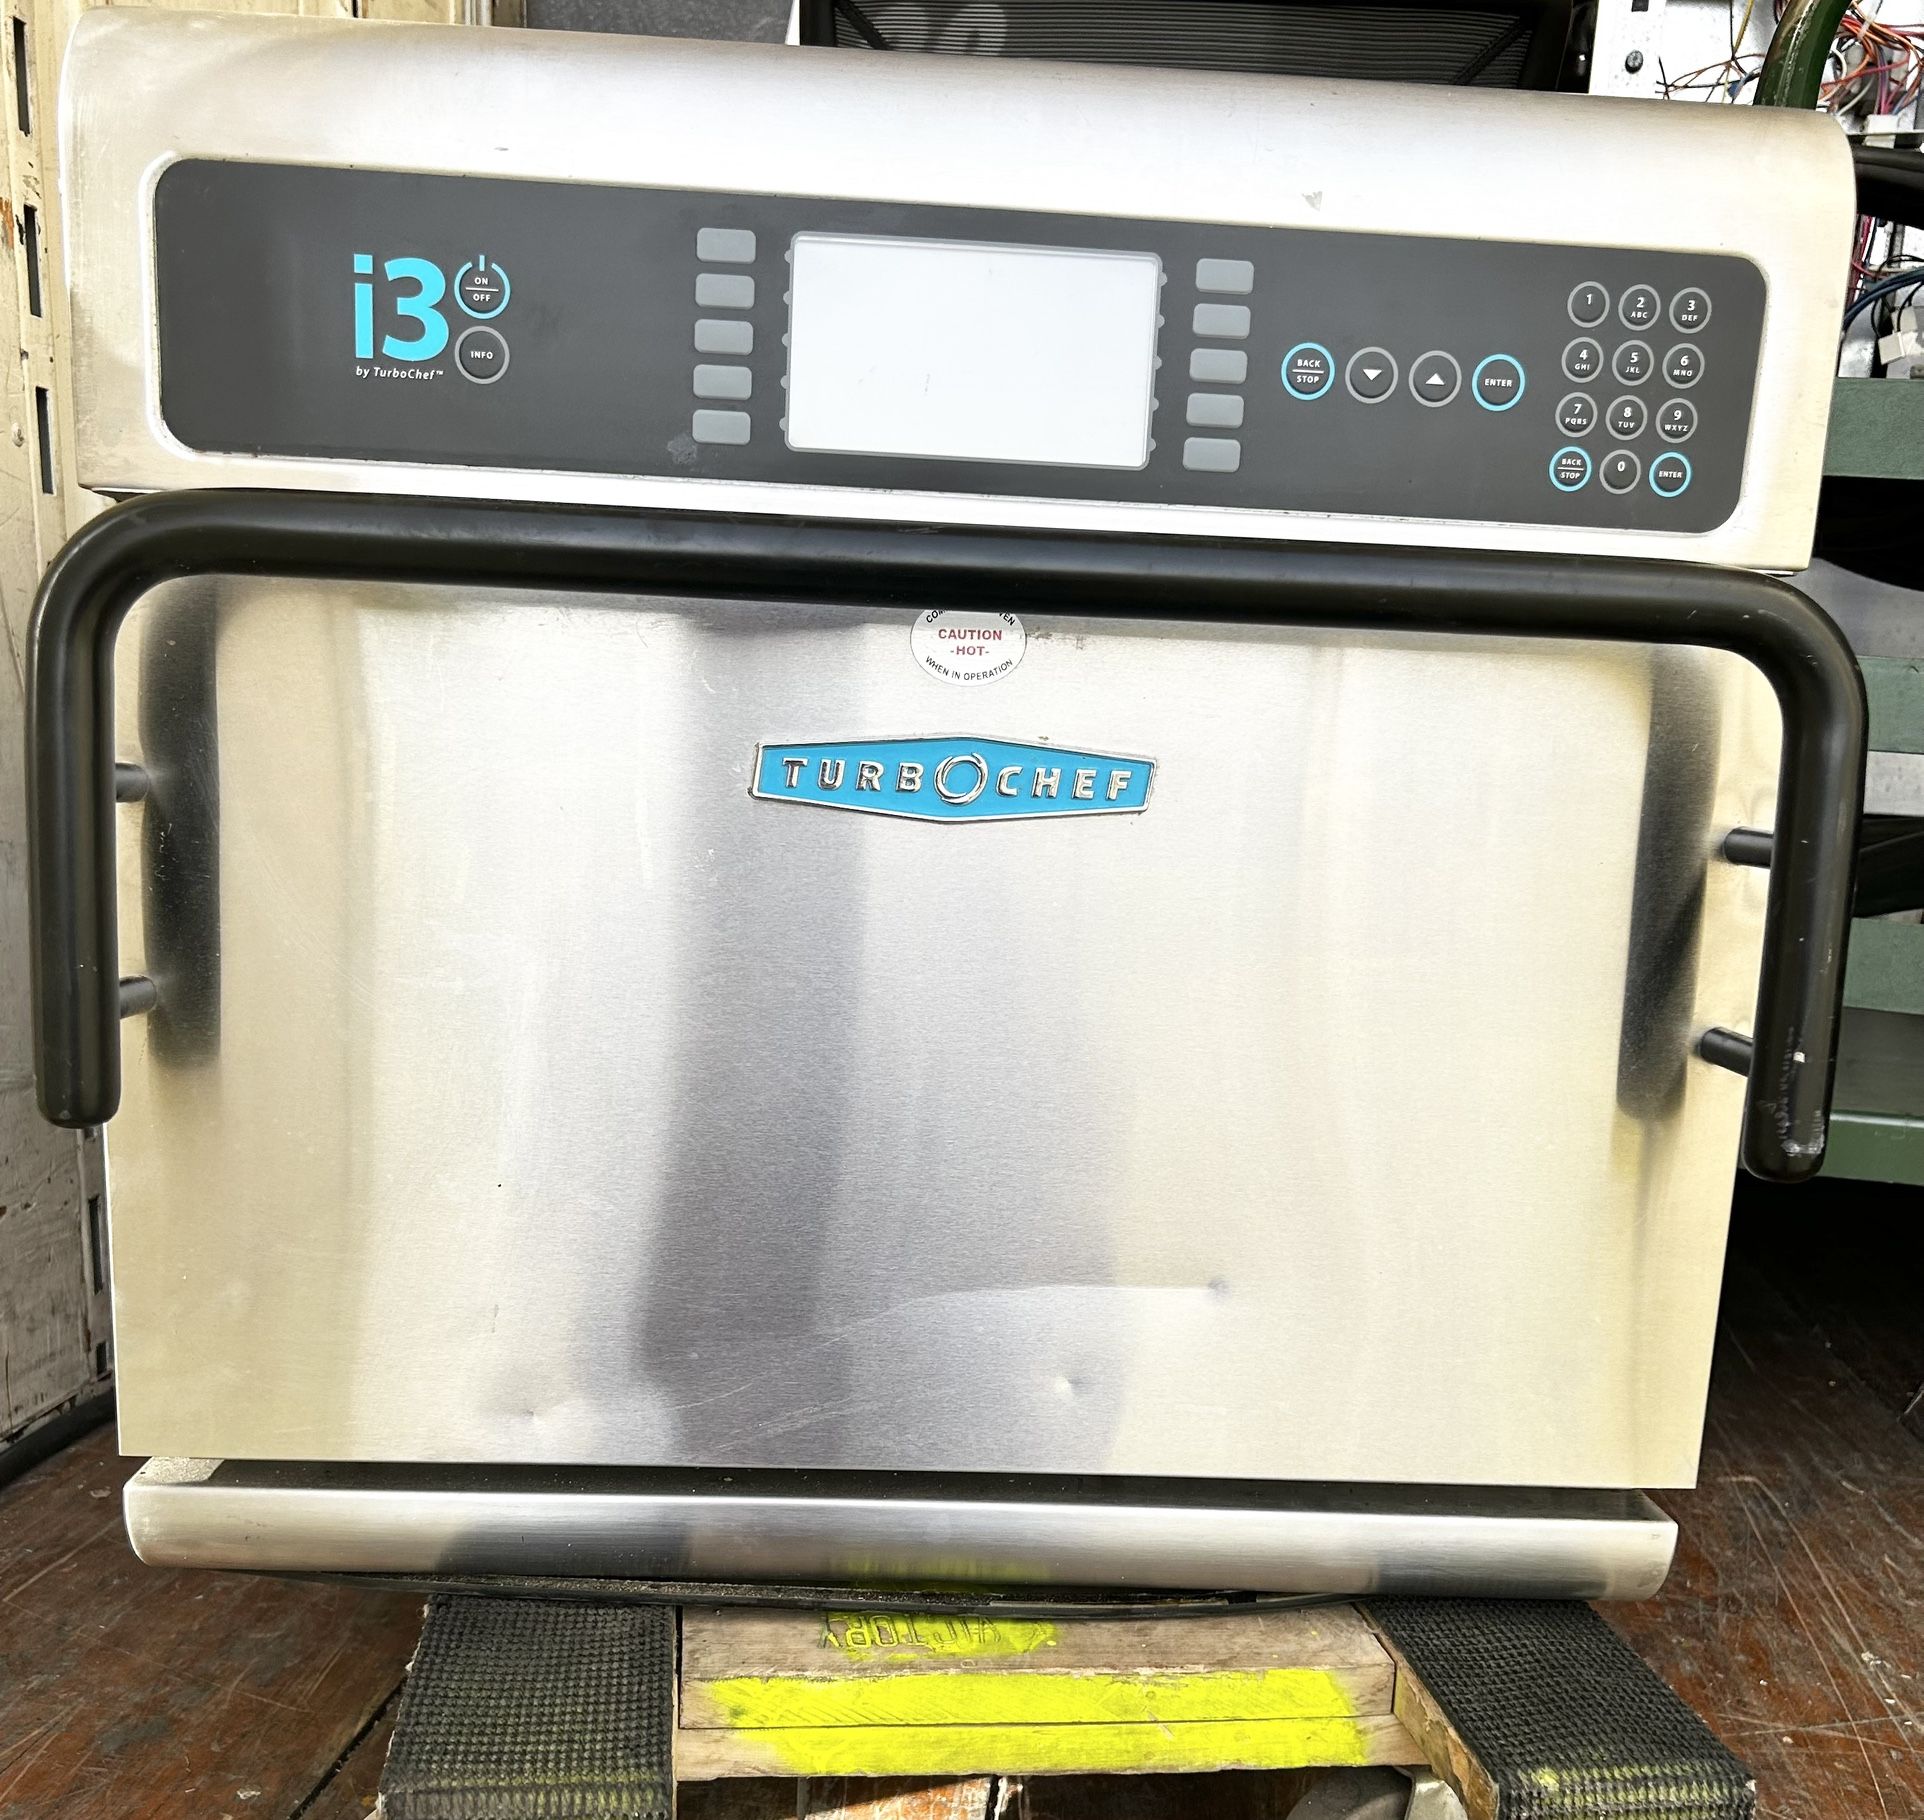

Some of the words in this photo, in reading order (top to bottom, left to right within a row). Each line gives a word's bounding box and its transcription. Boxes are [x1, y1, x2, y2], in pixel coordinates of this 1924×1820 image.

[474, 277, 489, 286] ON
[472, 293, 491, 302] OFF
[1586, 293, 1593, 305] 1
[353, 254, 449, 362] i3
[1636, 297, 1645, 309] 2
[1687, 300, 1696, 312] 3
[1630, 311, 1648, 319] ABC
[1681, 314, 1698, 322] DEF
[470, 351, 494, 360] INFO
[1579, 349, 1588, 361] 4
[1630, 352, 1639, 364] 5
[1297, 359, 1321, 369] BACK
[1680, 355, 1690, 367] 6
[1574, 363, 1590, 371] GHI
[1625, 366, 1641, 374] JKL
[355, 366, 370, 379] by
[1672, 369, 1693, 377] MNO
[1296, 375, 1320, 384] STOP
[1484, 378, 1513, 388] ENTER
[1573, 403, 1582, 415] 7
[1623, 406, 1632, 418] 8
[1673, 409, 1682, 421] 9
[1564, 417, 1587, 426] PQRS
[1618, 421, 1635, 429] TUV
[1664, 424, 1688, 432] WXYZ
[1561, 458, 1582, 466] BACK
[1617, 461, 1626, 472] 0
[1560, 471, 1580, 480] STOP
[1658, 470, 1683, 479] ENTER
[938, 628, 1003, 641] CAUTION
[925, 656, 950, 677] WHEN
[951, 670, 961, 680] IN
[963, 658, 1013, 681] OPERATION
